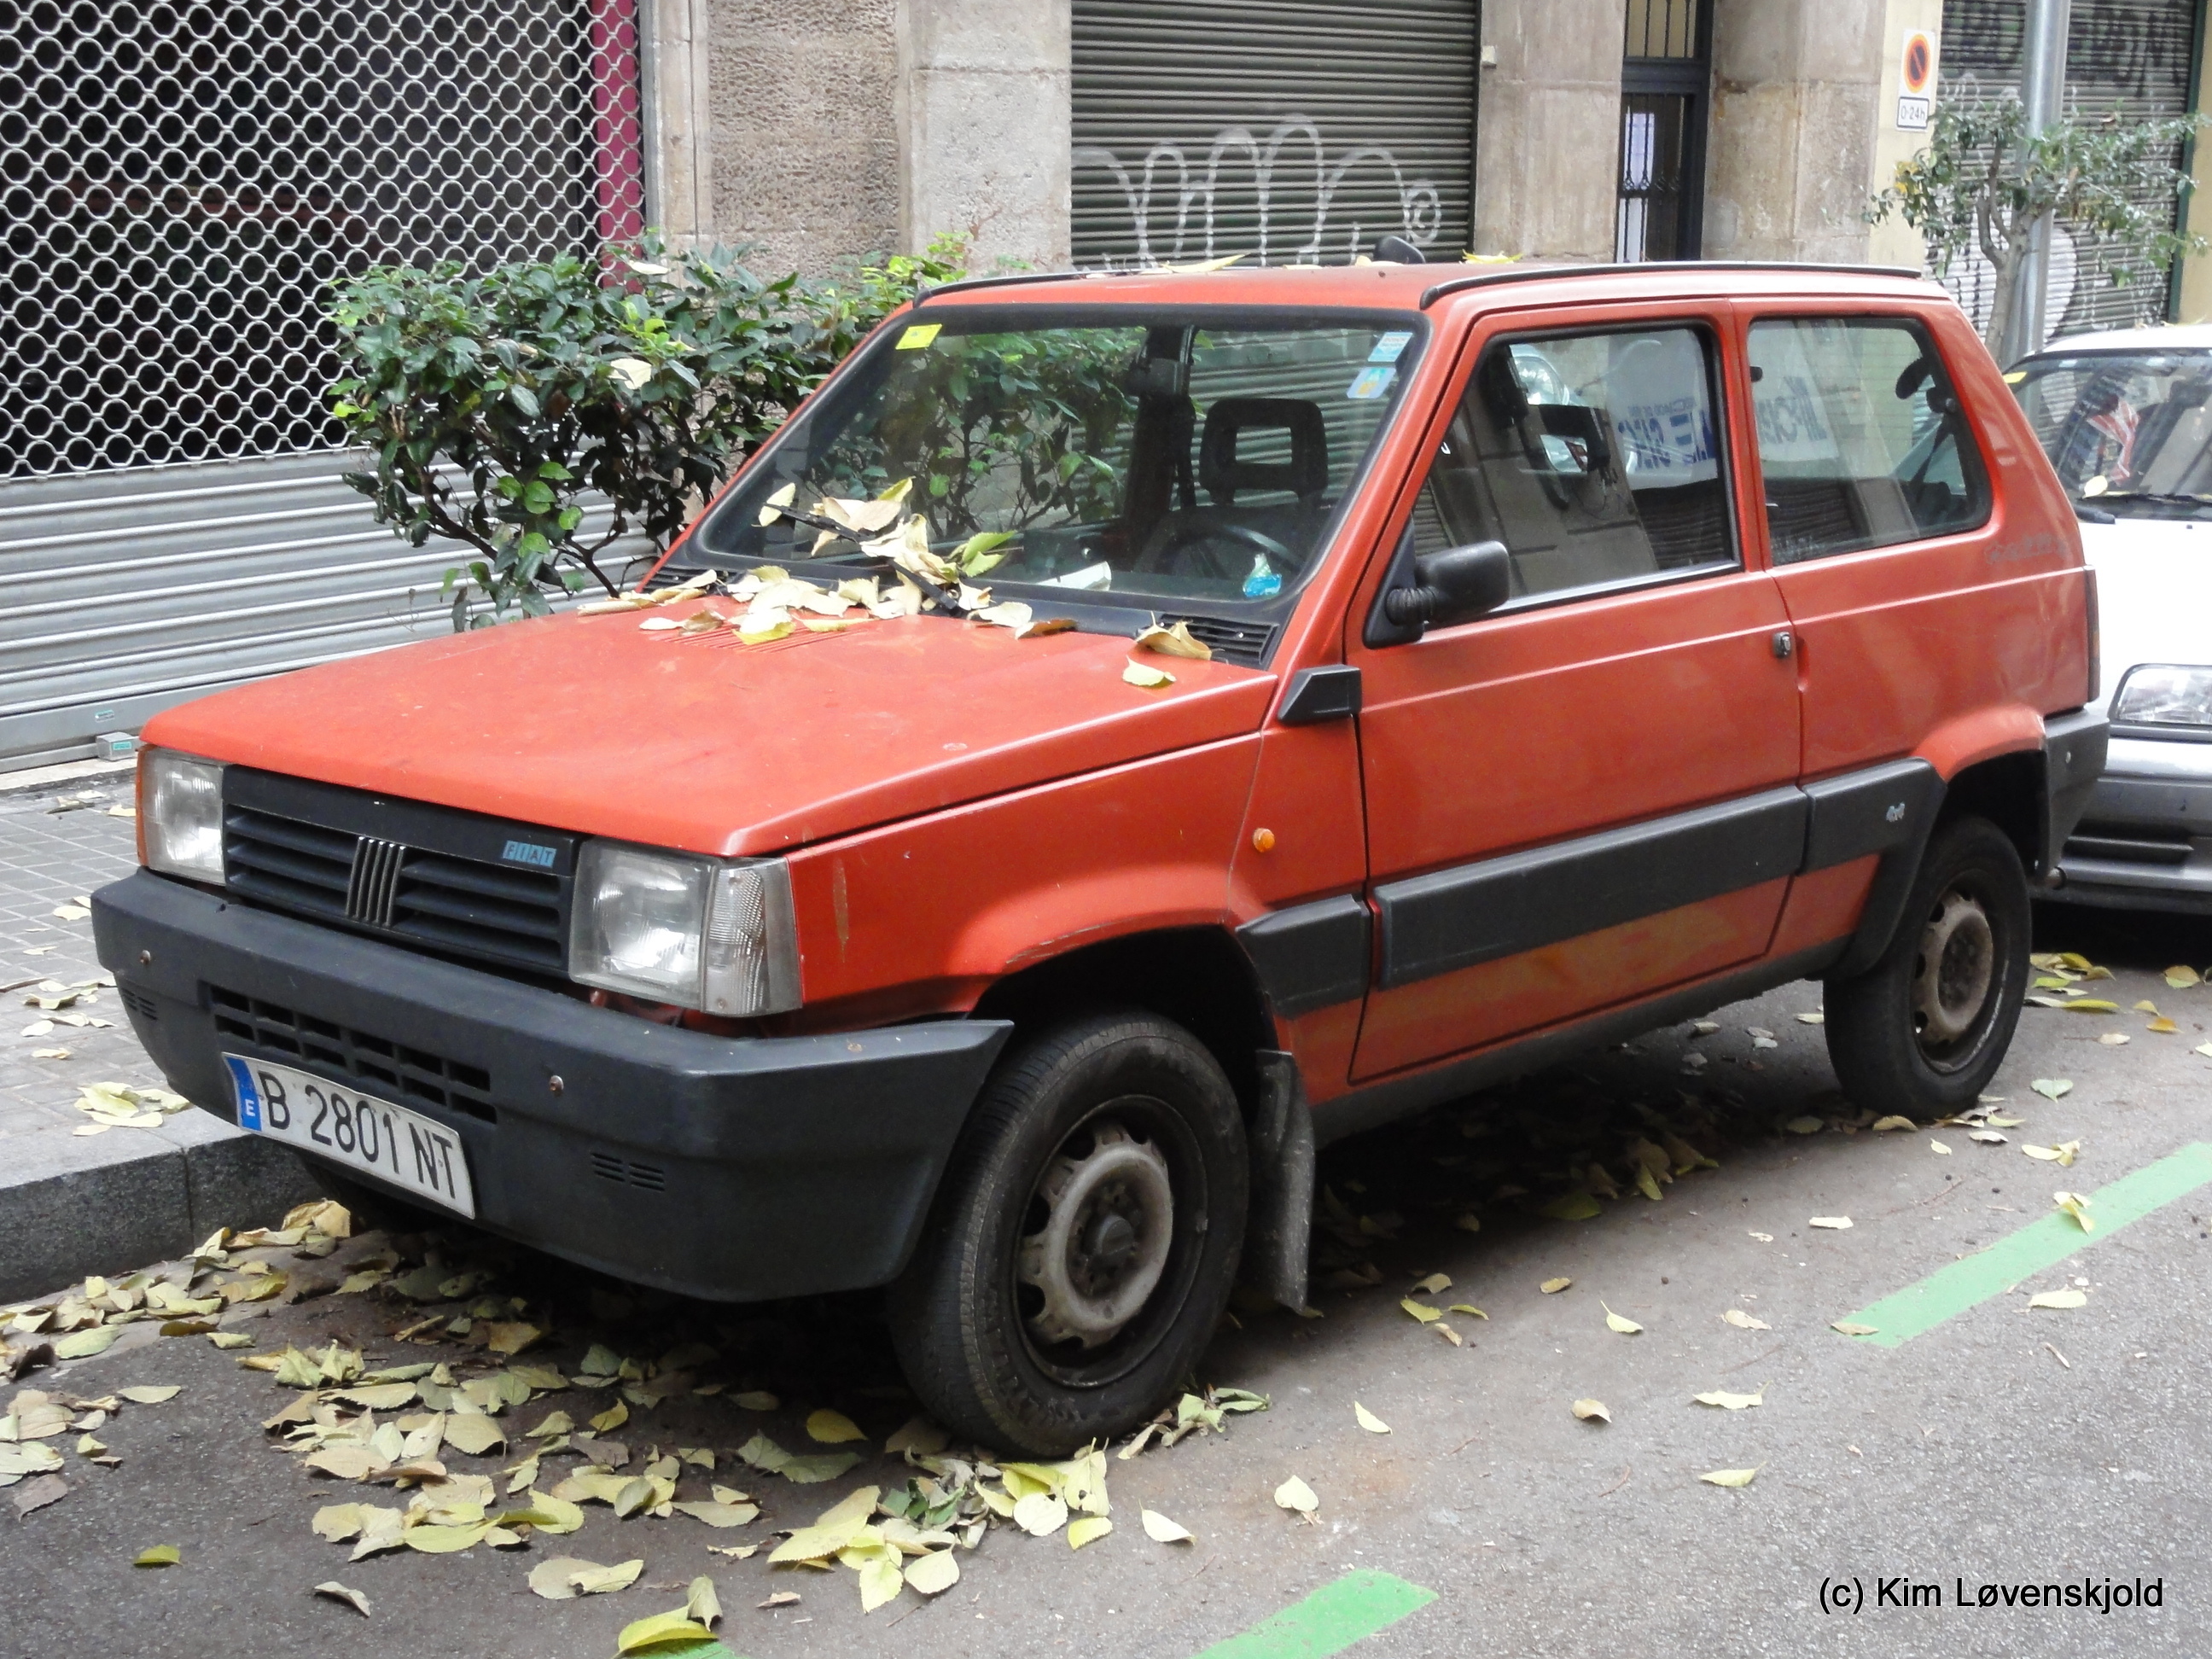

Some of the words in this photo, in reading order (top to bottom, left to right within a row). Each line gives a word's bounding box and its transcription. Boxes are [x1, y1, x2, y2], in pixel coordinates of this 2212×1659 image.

[504, 842, 555, 865] FIAT
[244, 1099, 256, 1117] E
[258, 1070, 291, 1130] B
[305, 1084, 401, 1175] 2801
[408, 1121, 456, 1200] NT
